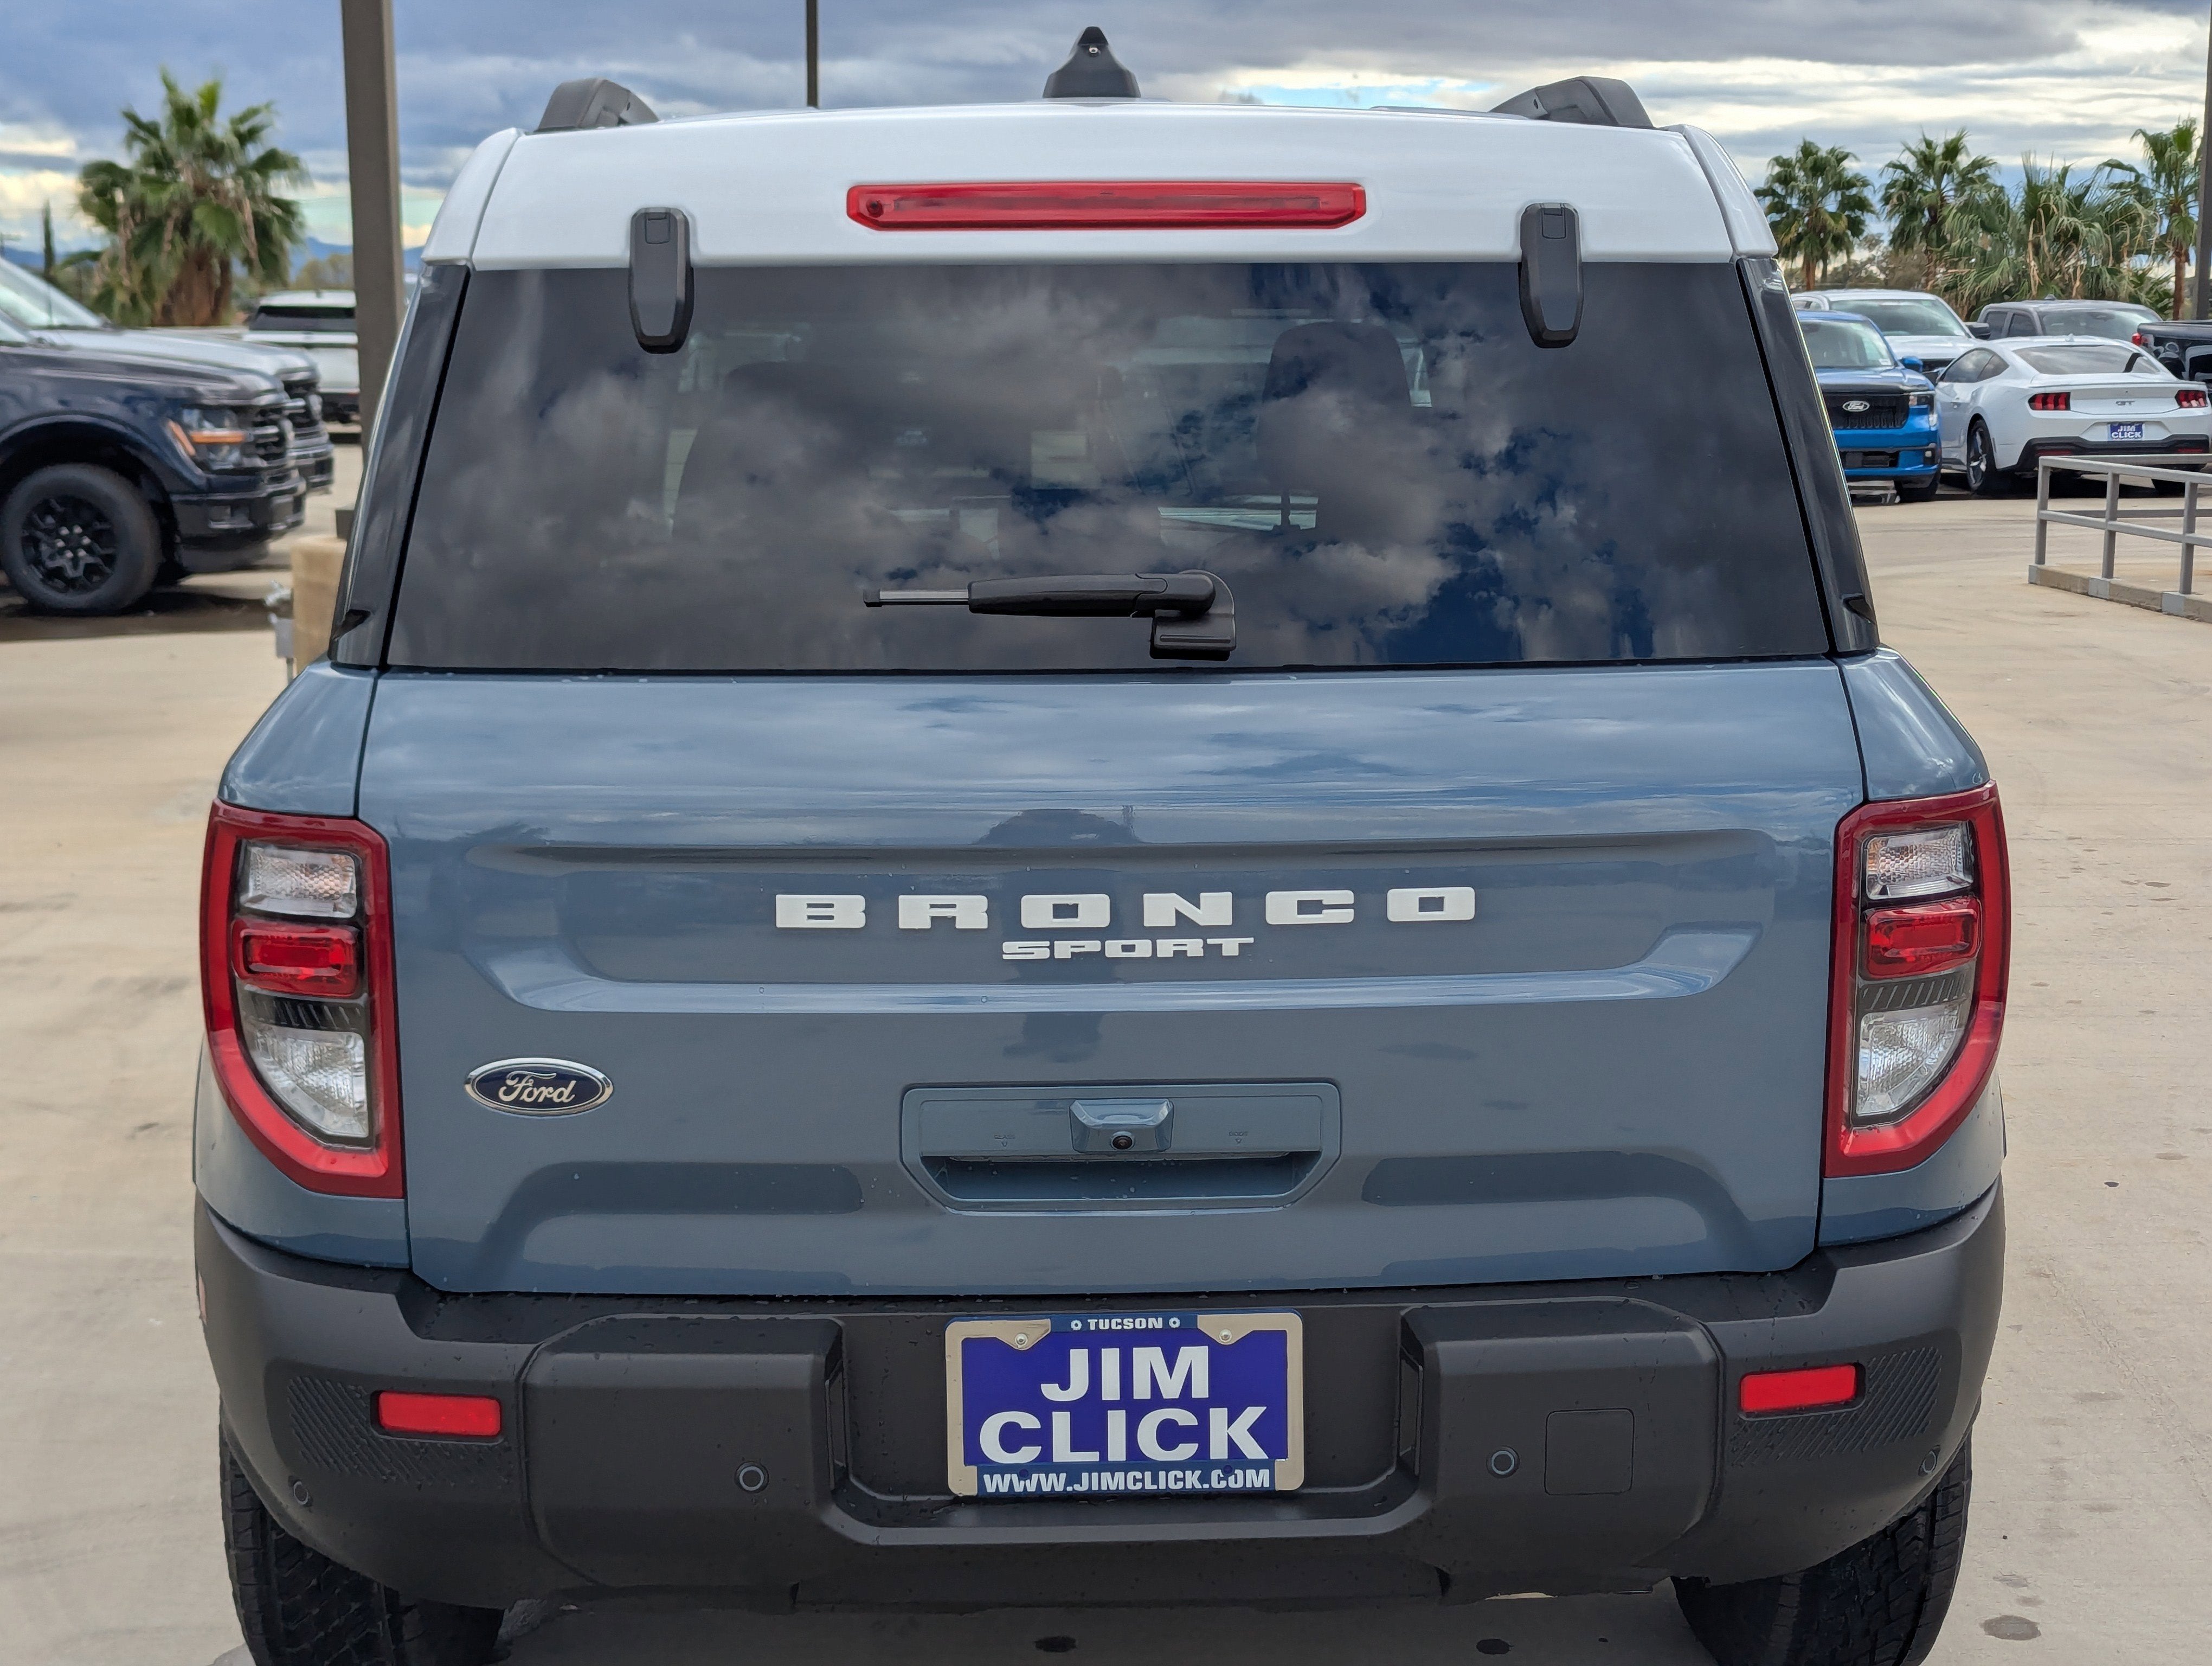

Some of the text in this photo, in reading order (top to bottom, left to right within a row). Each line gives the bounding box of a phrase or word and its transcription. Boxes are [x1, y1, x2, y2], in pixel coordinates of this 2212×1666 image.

[775, 887, 1475, 929] BRONCO
[1002, 937, 1254, 959] SPORT
[498, 1070, 577, 1103] Ford
[1086, 1317, 1163, 1331] TUCSON
[1040, 1345, 1210, 1402] JIM
[979, 1406, 1269, 1464] CLICK
[982, 1469, 1270, 1492] WWW.JIMCLICK.COM
